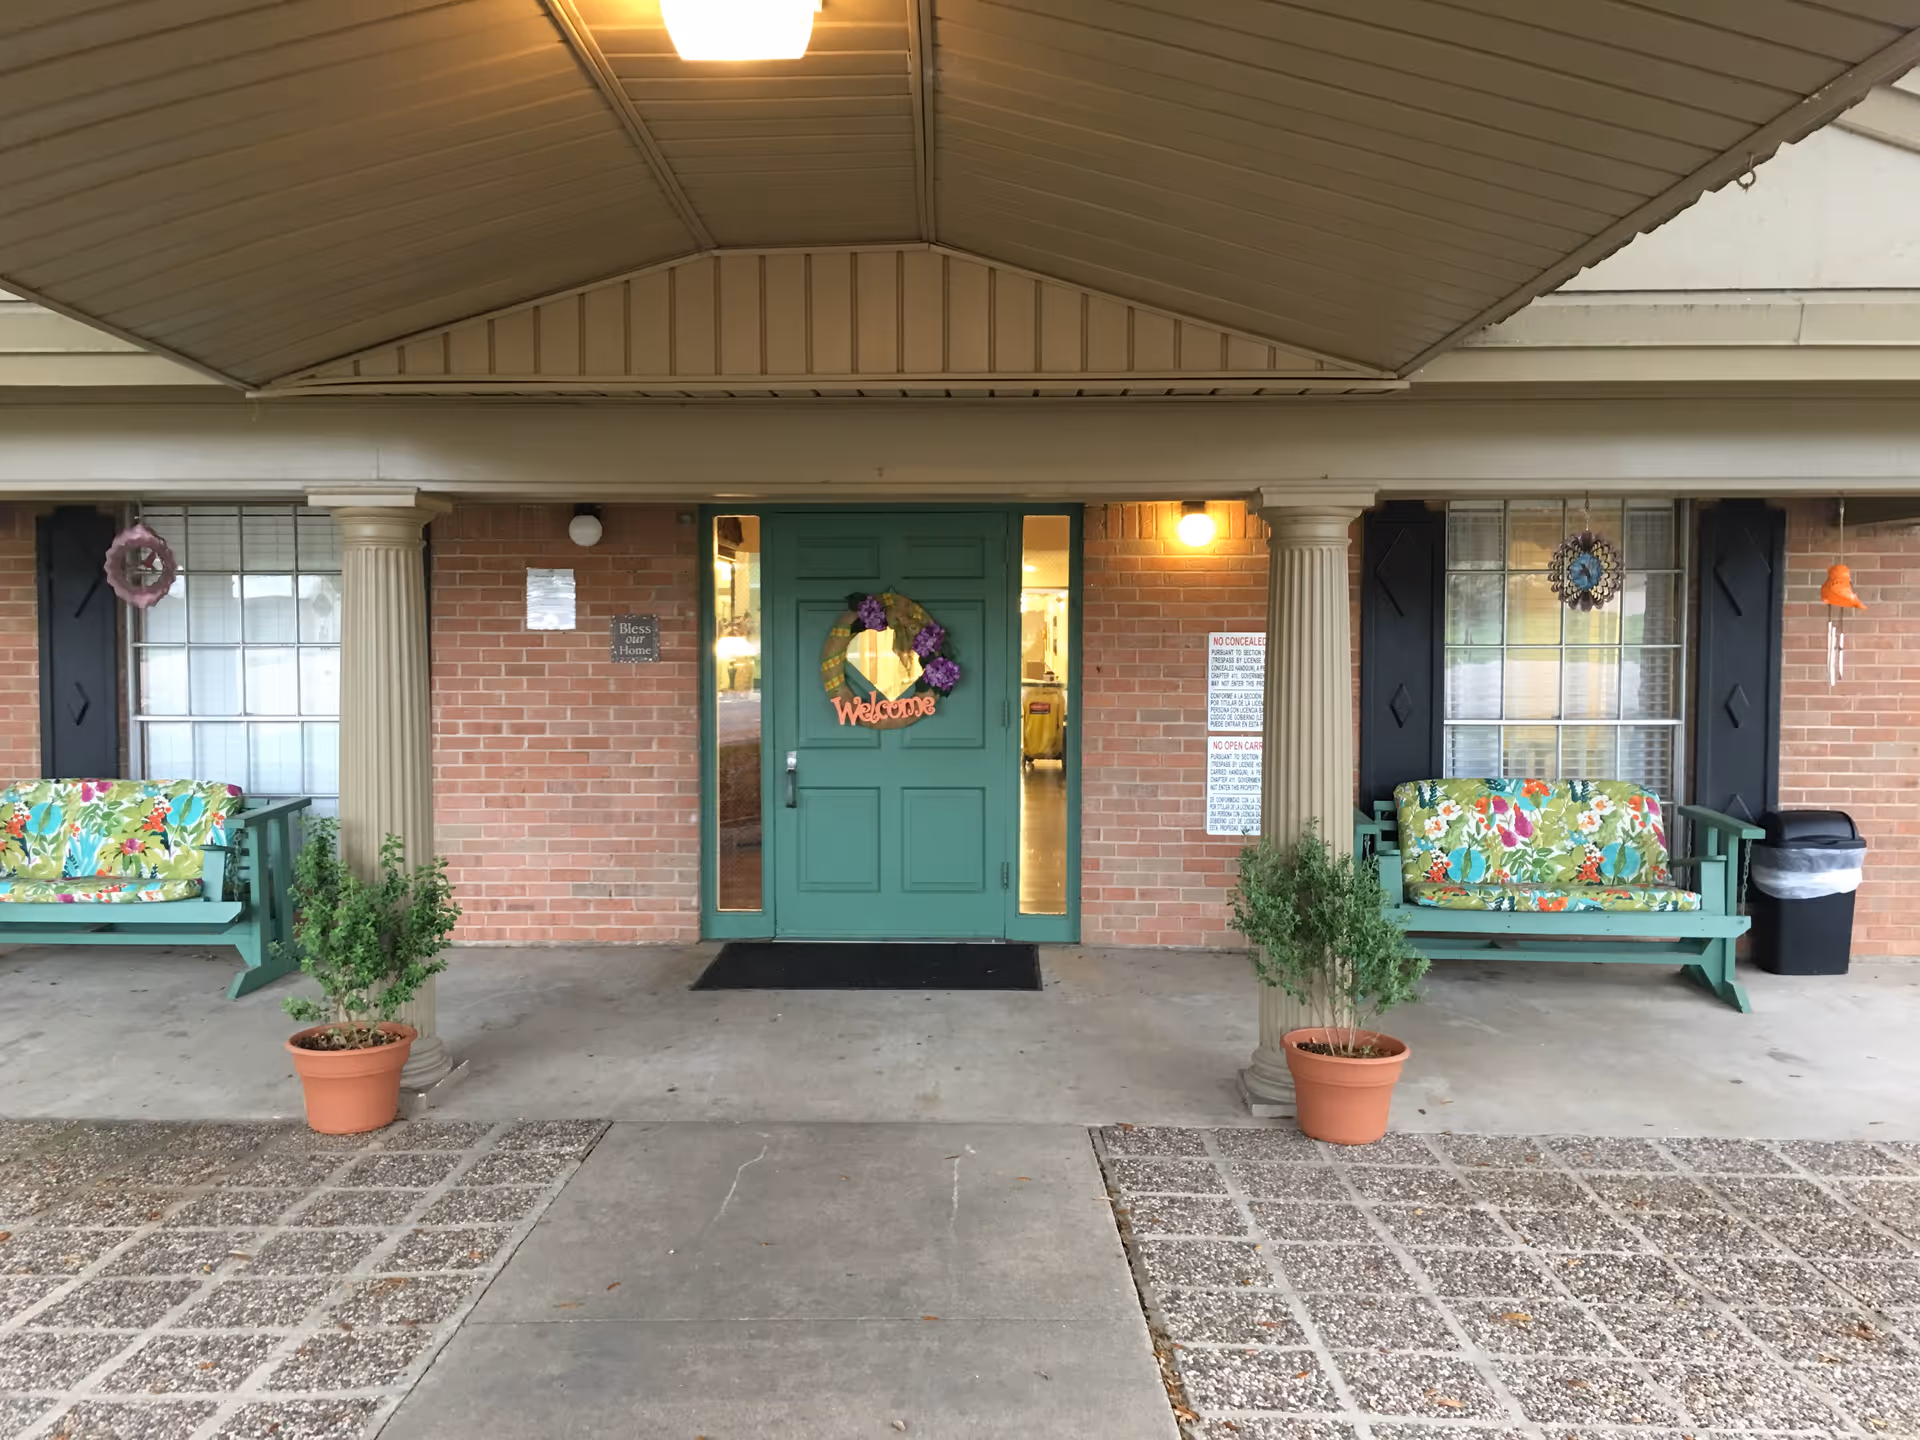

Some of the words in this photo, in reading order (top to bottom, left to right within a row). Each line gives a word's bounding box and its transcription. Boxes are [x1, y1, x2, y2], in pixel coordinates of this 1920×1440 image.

[619, 622, 651, 634] Bless
[625, 636, 645, 644] our
[1214, 637, 1223, 646] NO
[1225, 637, 1266, 646] CONCEALED
[619, 645, 651, 655] Home
[830, 690, 936, 726] Welcome
[1213, 741, 1222, 750] NO
[1224, 741, 1242, 750] OPEN
